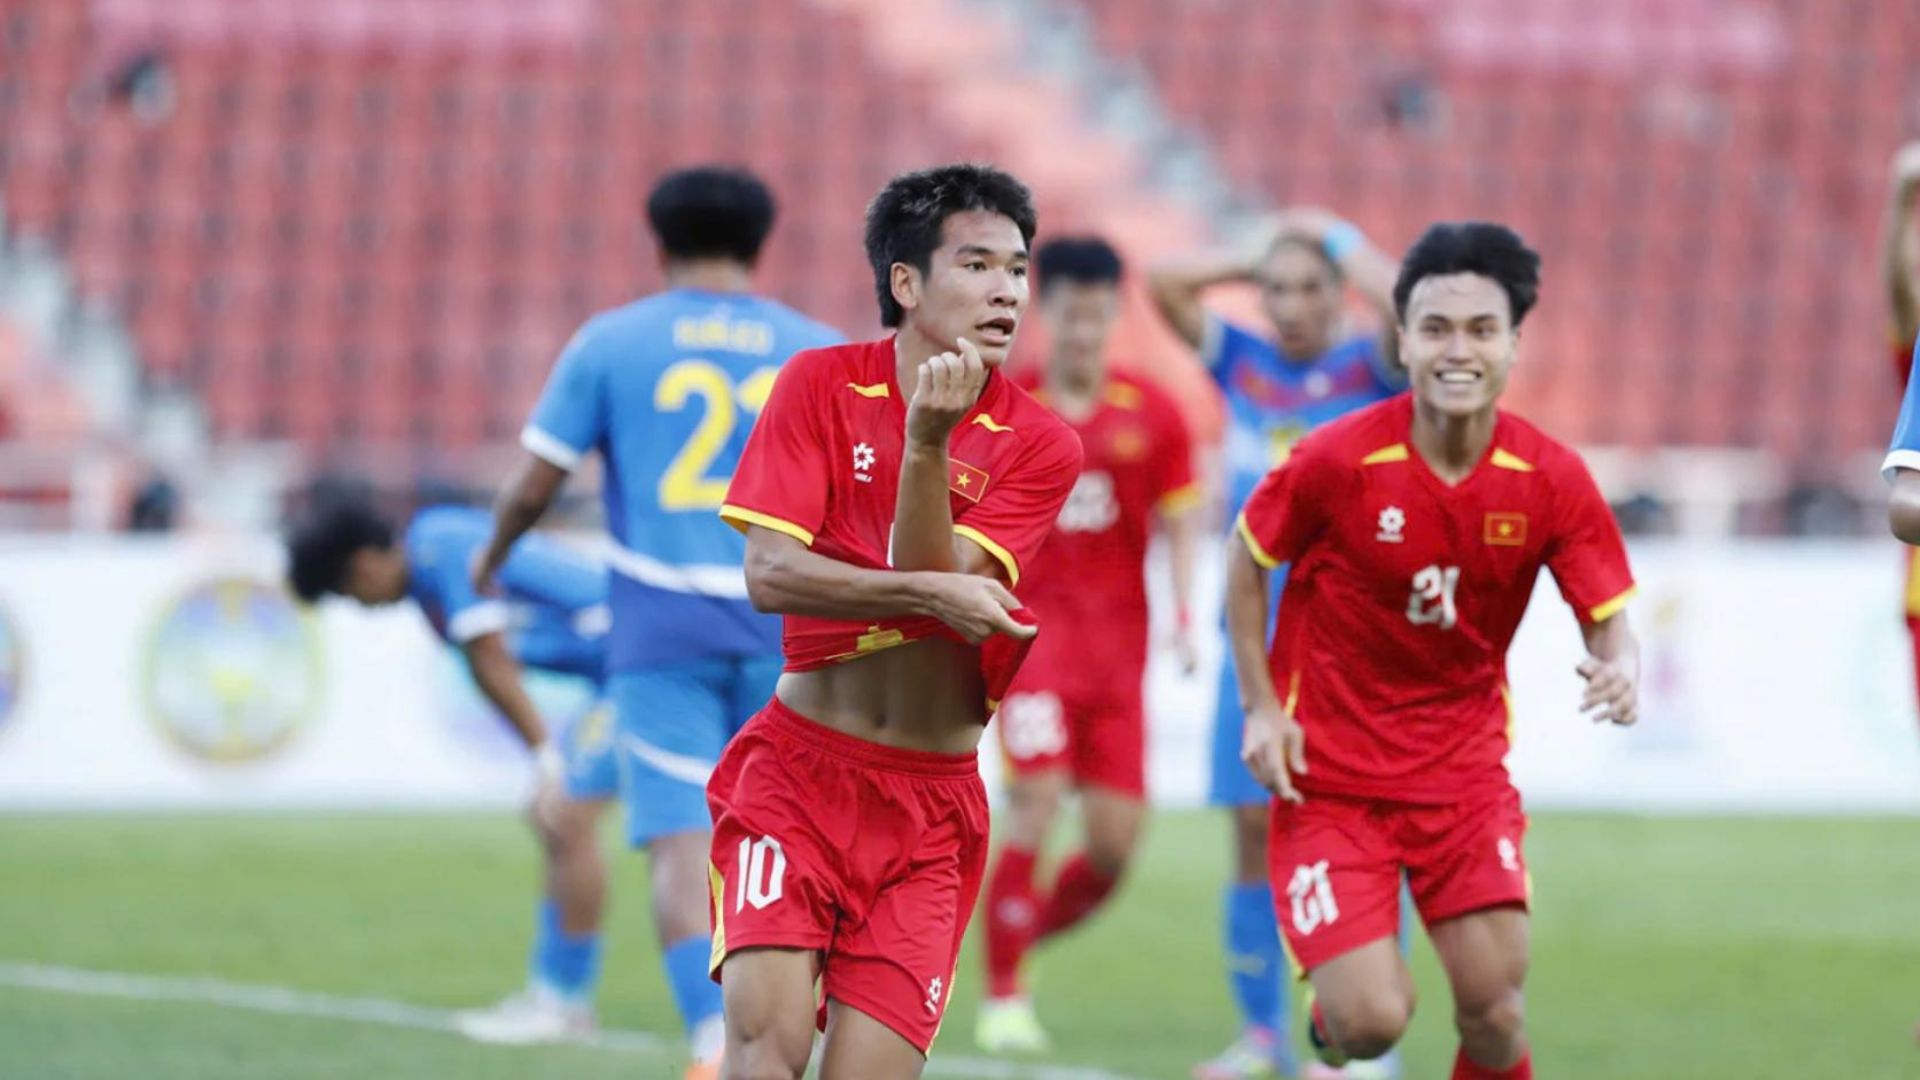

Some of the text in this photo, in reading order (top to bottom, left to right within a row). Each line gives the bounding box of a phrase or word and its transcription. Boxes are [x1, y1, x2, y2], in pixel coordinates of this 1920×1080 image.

[1406, 565, 1460, 630] 21
[736, 834, 787, 914] 10
[1287, 860, 1339, 935] 21
